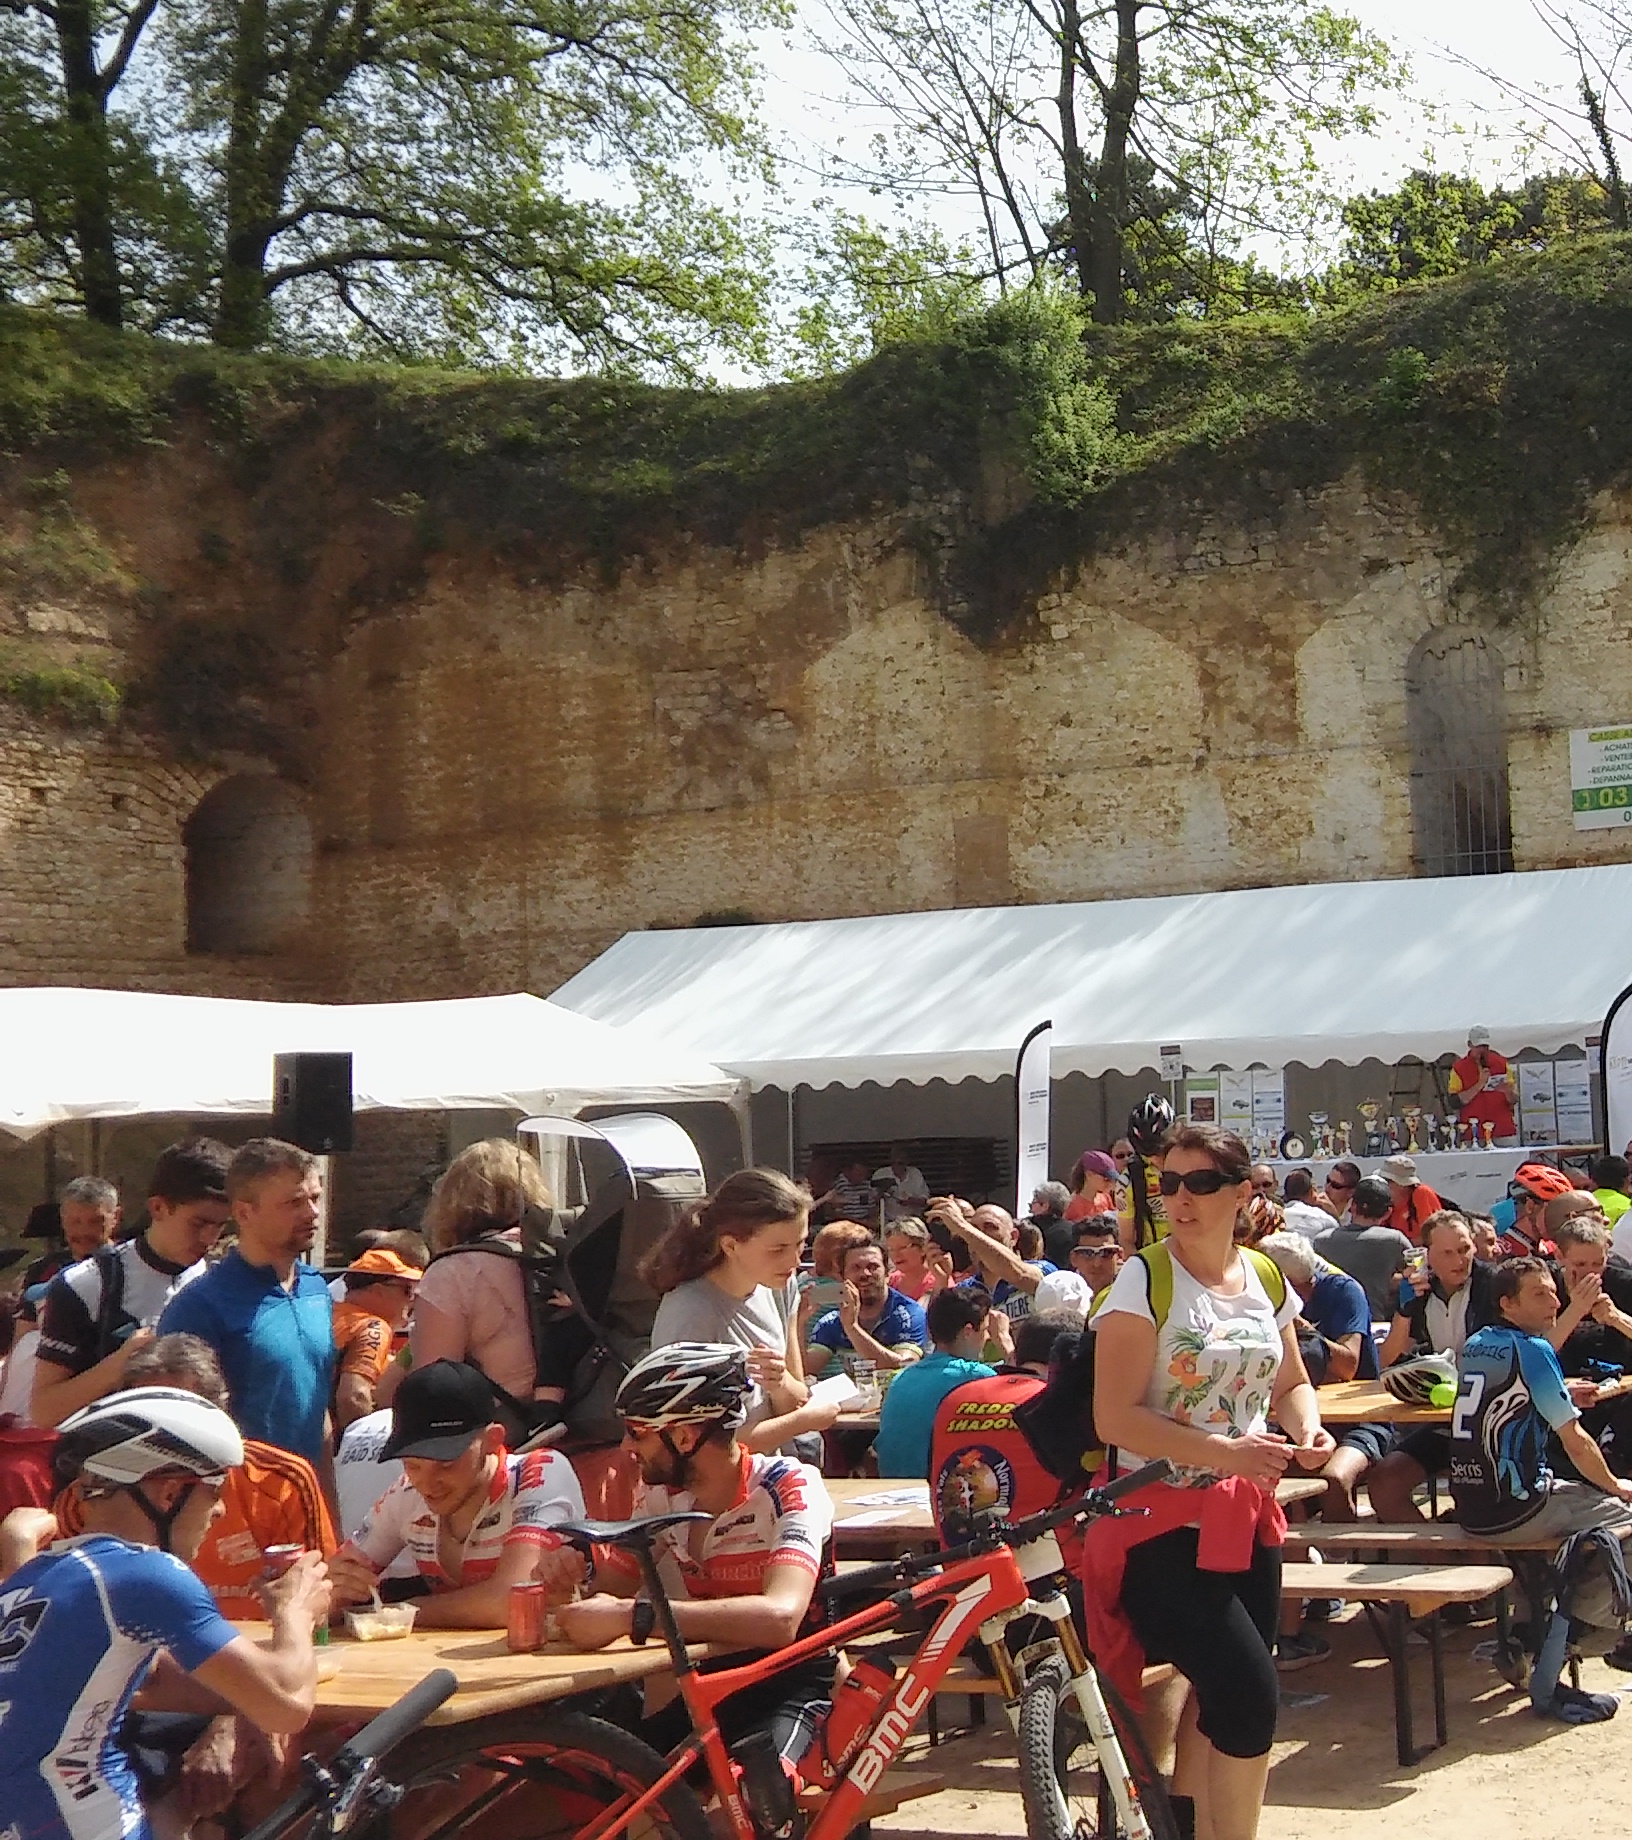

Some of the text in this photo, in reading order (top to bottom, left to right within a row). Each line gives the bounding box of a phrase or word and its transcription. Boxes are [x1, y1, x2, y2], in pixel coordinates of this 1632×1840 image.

[1600, 786, 1628, 807] 03
[1453, 1374, 1485, 1439] 2
[1451, 1456, 1483, 1477] Serris
[848, 1673, 930, 1795] BMC
[728, 1794, 750, 1830] BMC
